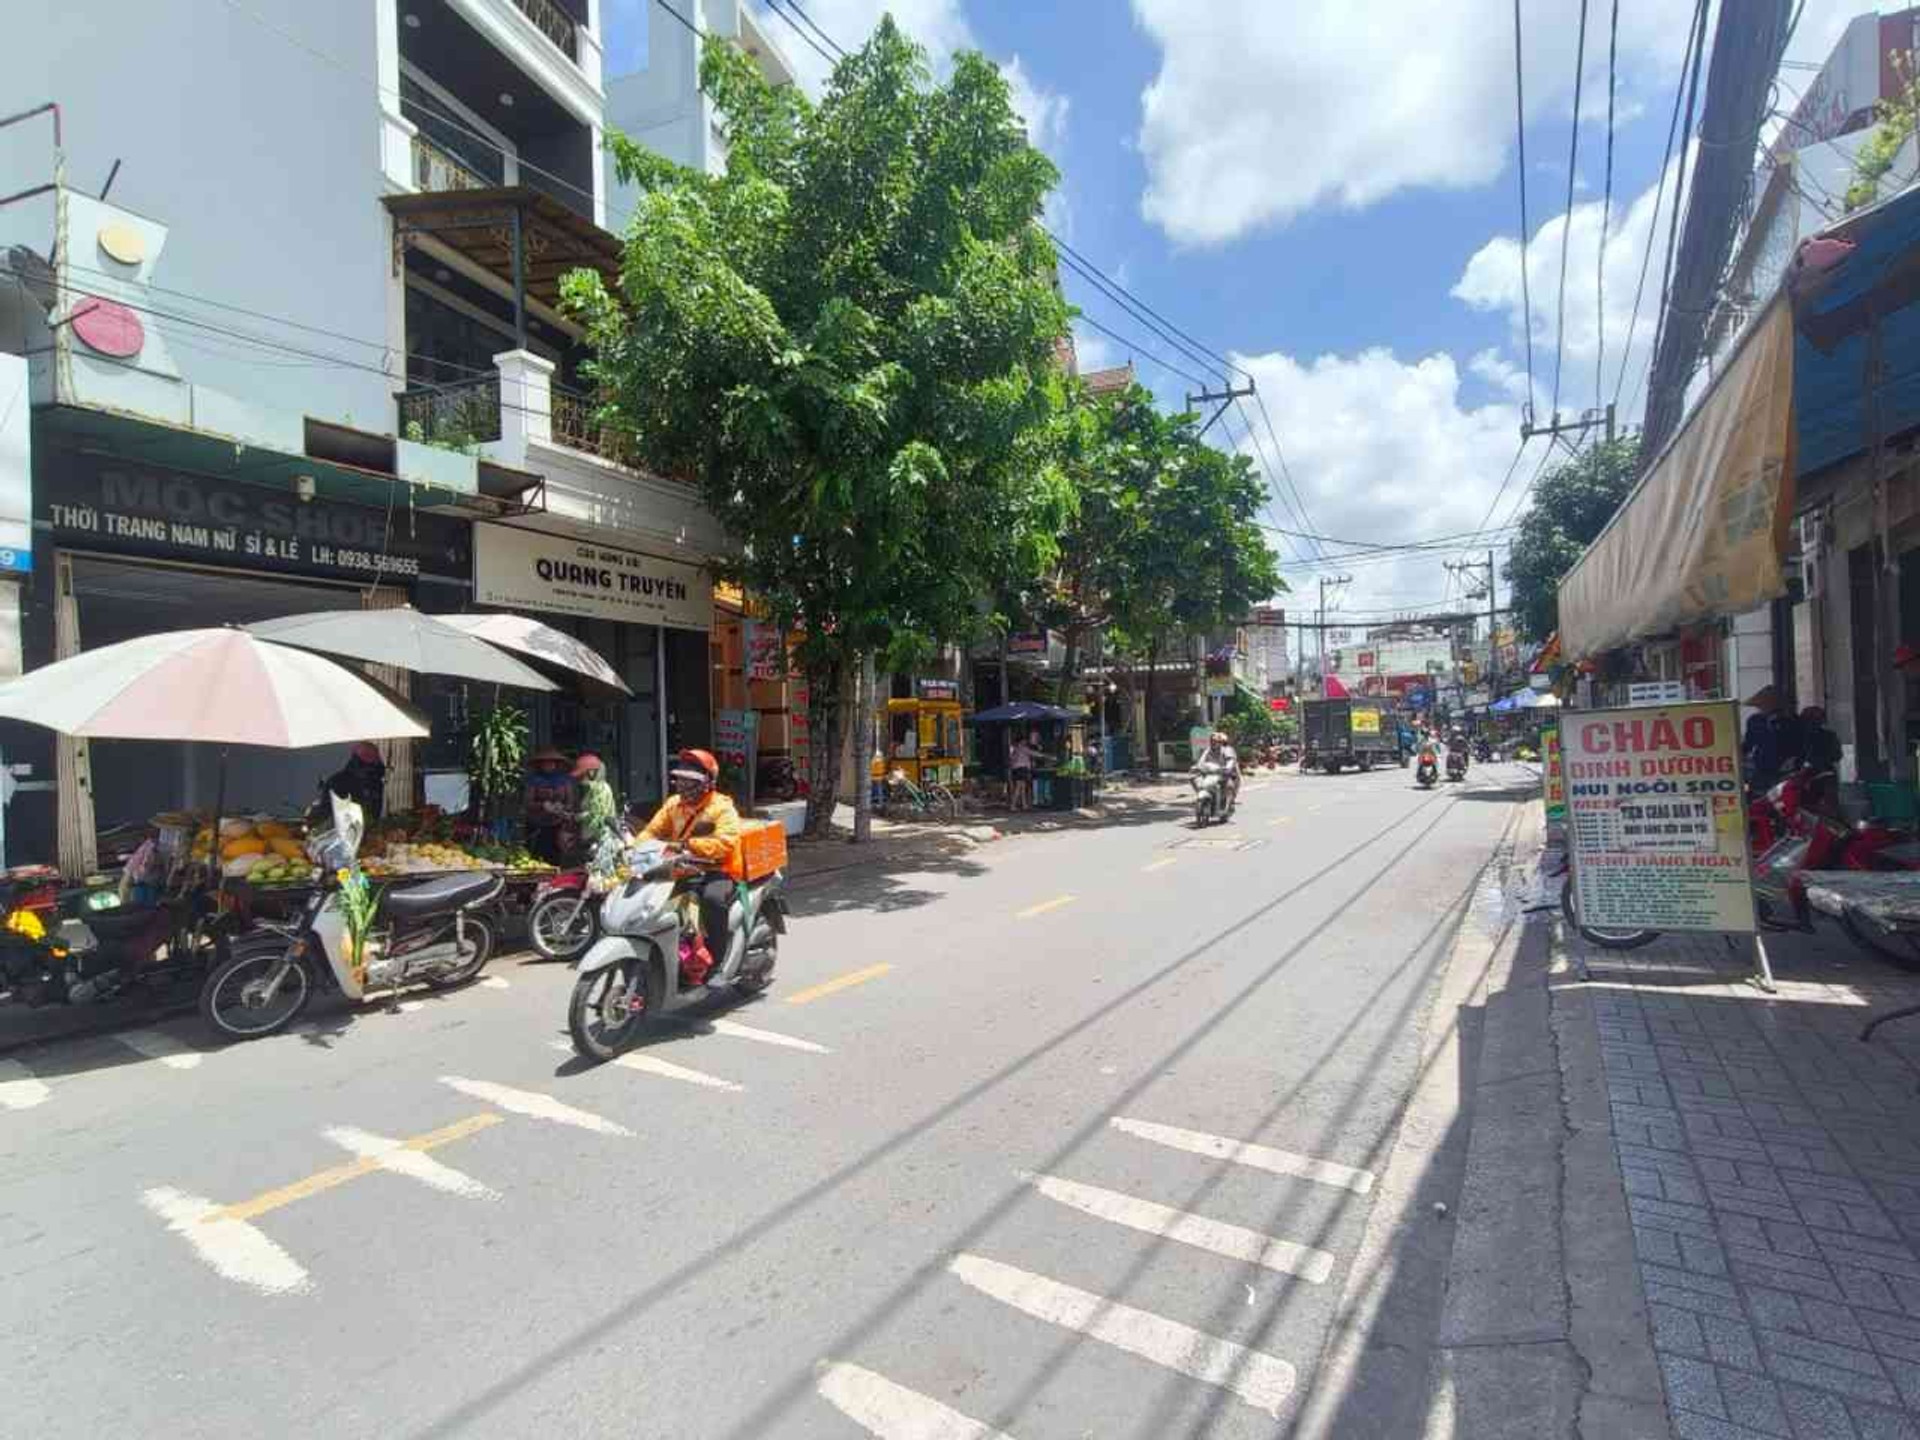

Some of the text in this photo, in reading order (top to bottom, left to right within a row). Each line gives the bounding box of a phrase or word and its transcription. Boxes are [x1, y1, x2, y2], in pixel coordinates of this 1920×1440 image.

[104, 513, 167, 541] TRANG
[171, 524, 208, 547] NAM
[213, 526, 237, 551] NỮ
[265, 538, 277, 556] &
[537, 558, 611, 587] QUANG
